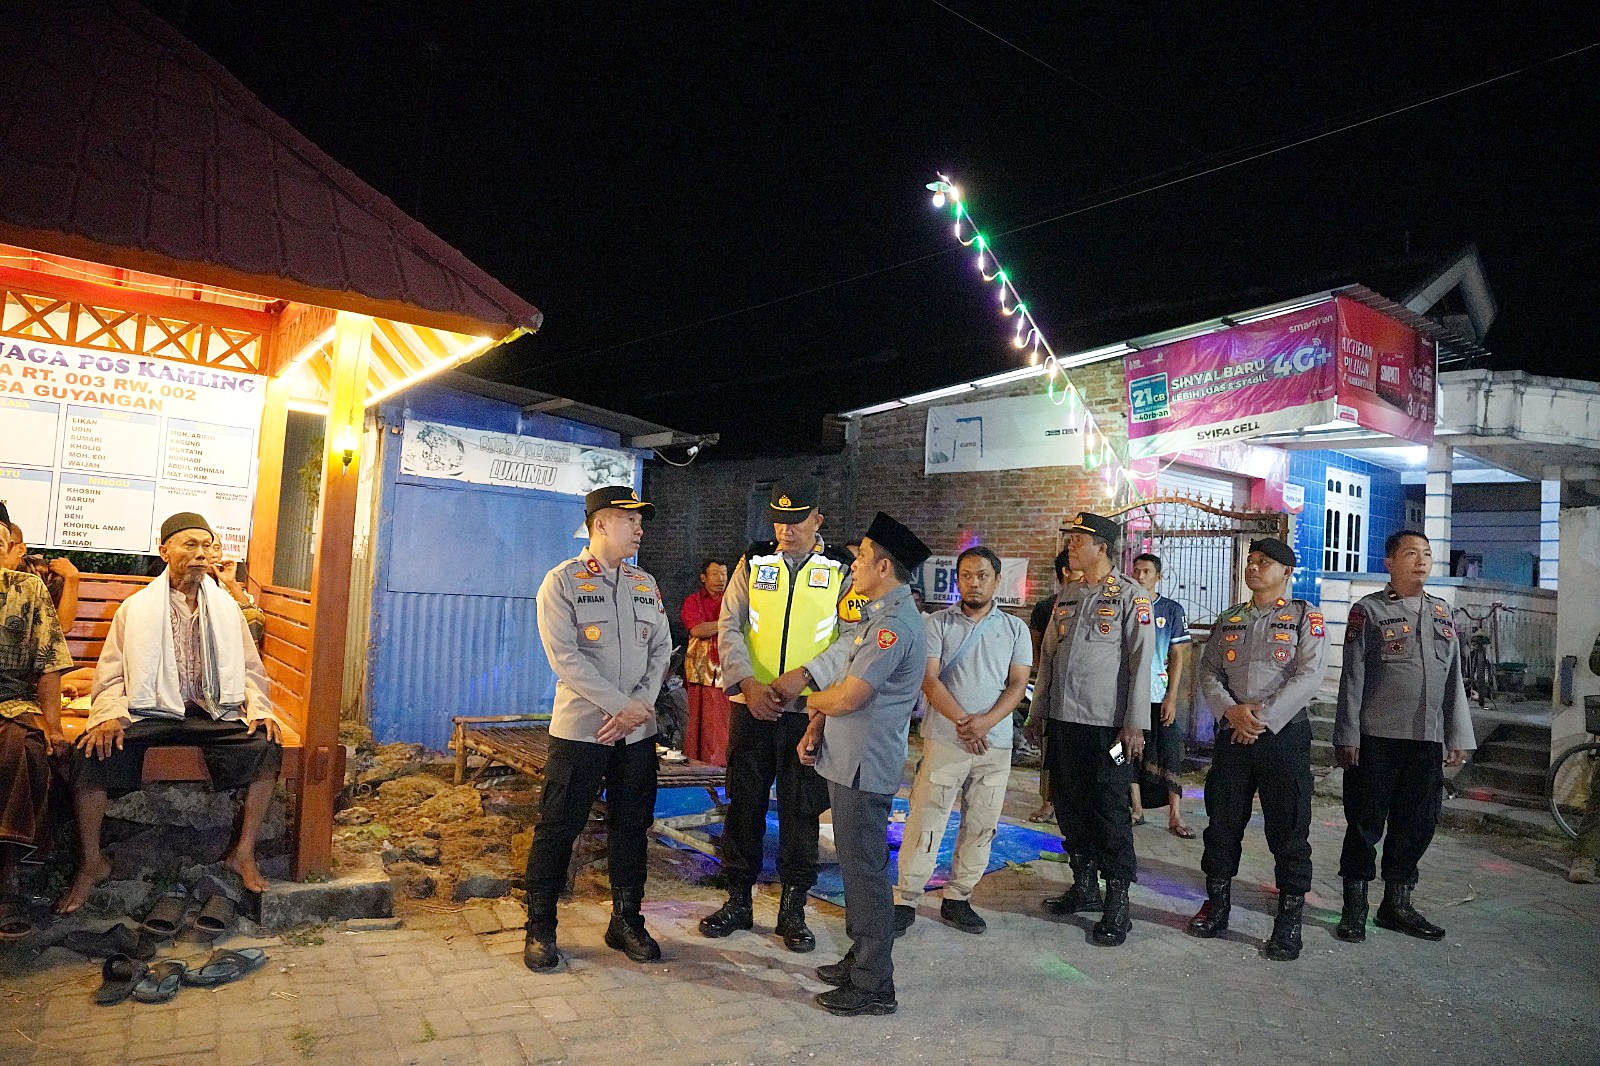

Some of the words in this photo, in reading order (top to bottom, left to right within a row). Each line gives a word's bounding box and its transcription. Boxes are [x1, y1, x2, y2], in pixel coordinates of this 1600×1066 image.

[1288, 314, 1333, 334] smartfren
[78, 354, 130, 374] POS
[137, 361, 255, 393] KAMLING
[1170, 370, 1221, 391] SINYAL
[1223, 358, 1265, 378] BARU
[22, 366, 56, 382] RT.
[65, 373, 105, 388] 003
[113, 378, 152, 394] RW.
[160, 385, 197, 401] 002
[33, 384, 163, 411] GUYANGAN
[1132, 387, 1153, 408] 21
[1153, 393, 1166, 403] GB
[1171, 391, 1200, 403] LEBIH
[1202, 384, 1227, 396] LUAS
[72, 417, 97, 425] LIKAN
[1197, 427, 1230, 440] SYIFA
[1233, 421, 1260, 434] CELL
[70, 434, 102, 443] SUMARI
[68, 460, 100, 468] WAIJAN
[489, 459, 558, 486] LUMINTU
[88, 477, 129, 488] MINGGU
[66, 495, 95, 504] DARUM
[63, 522, 100, 530] KHOIRUL
[936, 558, 952, 567] Agen
[577, 595, 605, 604] AFRIAN
[634, 596, 655, 606] POLRI
[994, 596, 1021, 605] ONLINE
